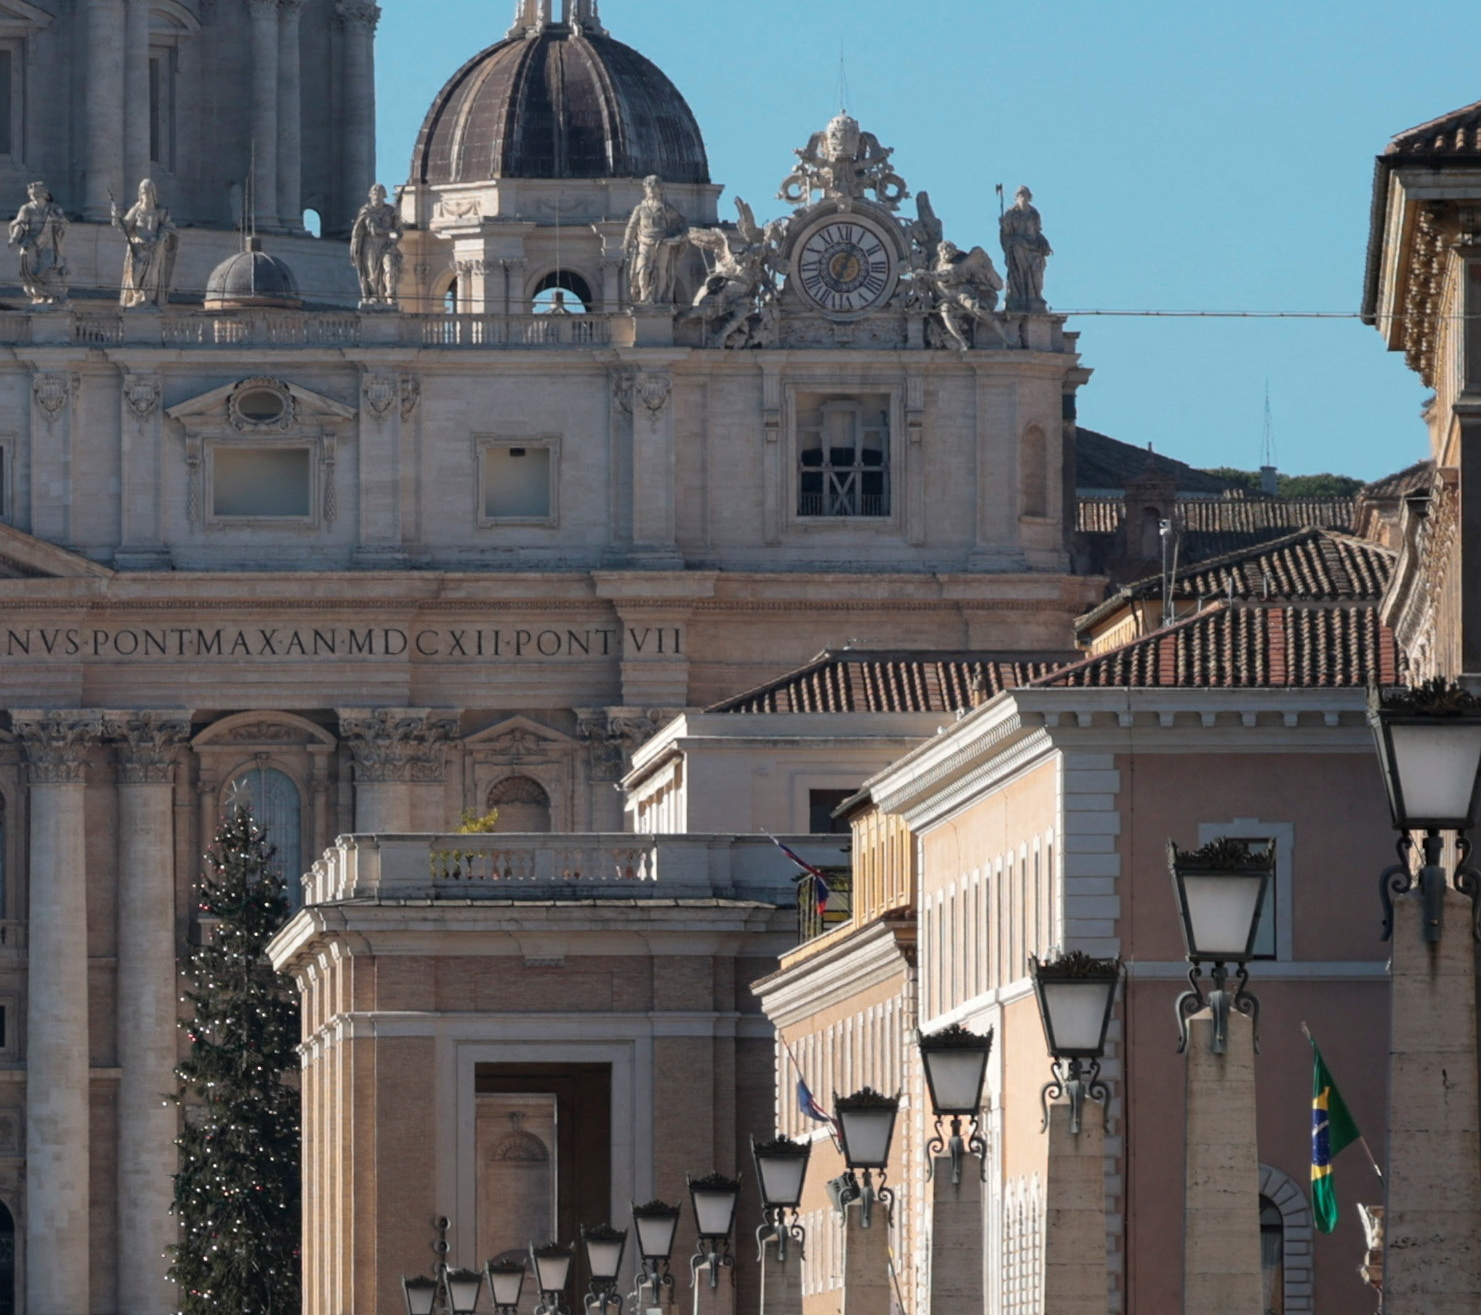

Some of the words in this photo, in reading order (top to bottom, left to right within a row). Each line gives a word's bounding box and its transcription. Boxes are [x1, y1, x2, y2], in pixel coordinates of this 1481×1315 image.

[92, 628, 190, 656] PONT
[192, 628, 280, 656] MAX
[284, 628, 338, 656] AN
[346, 628, 502, 656] MDCXII
[515, 628, 617, 656] PONT
[628, 627, 683, 654] VII
